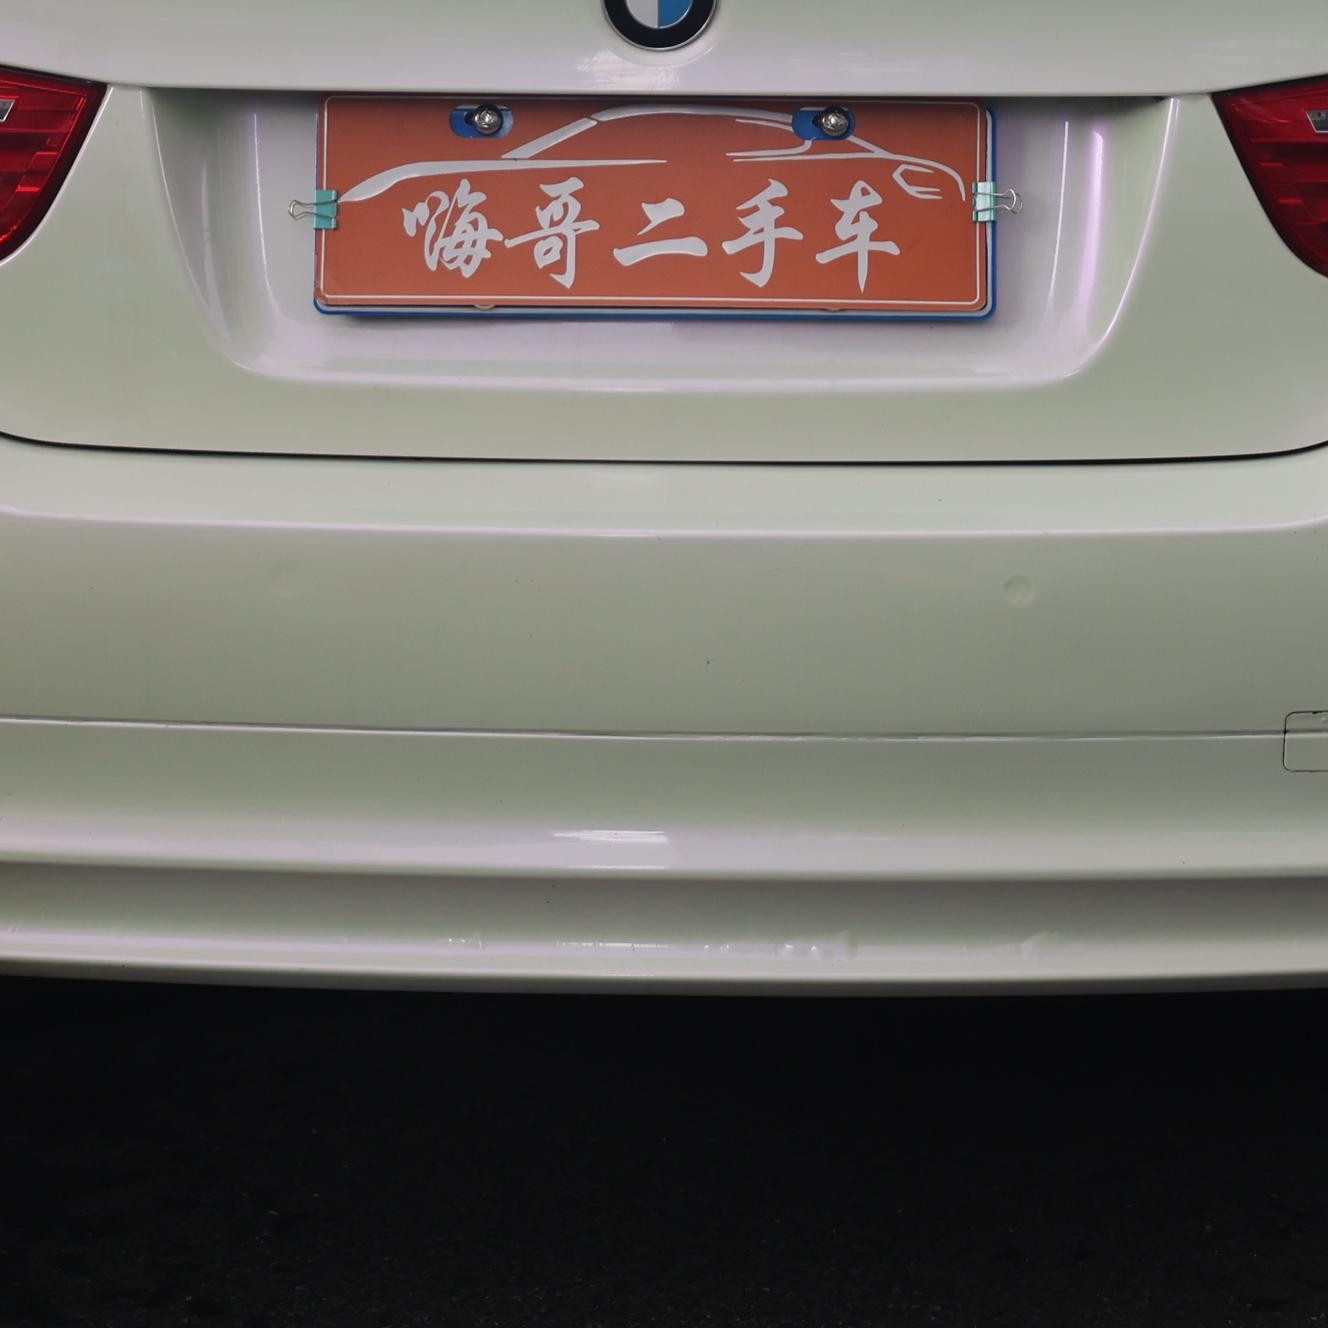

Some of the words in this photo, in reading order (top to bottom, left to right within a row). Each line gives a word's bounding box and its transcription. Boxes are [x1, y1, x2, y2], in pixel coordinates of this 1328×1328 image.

[402, 176, 900, 294] 嗨哥二手车
